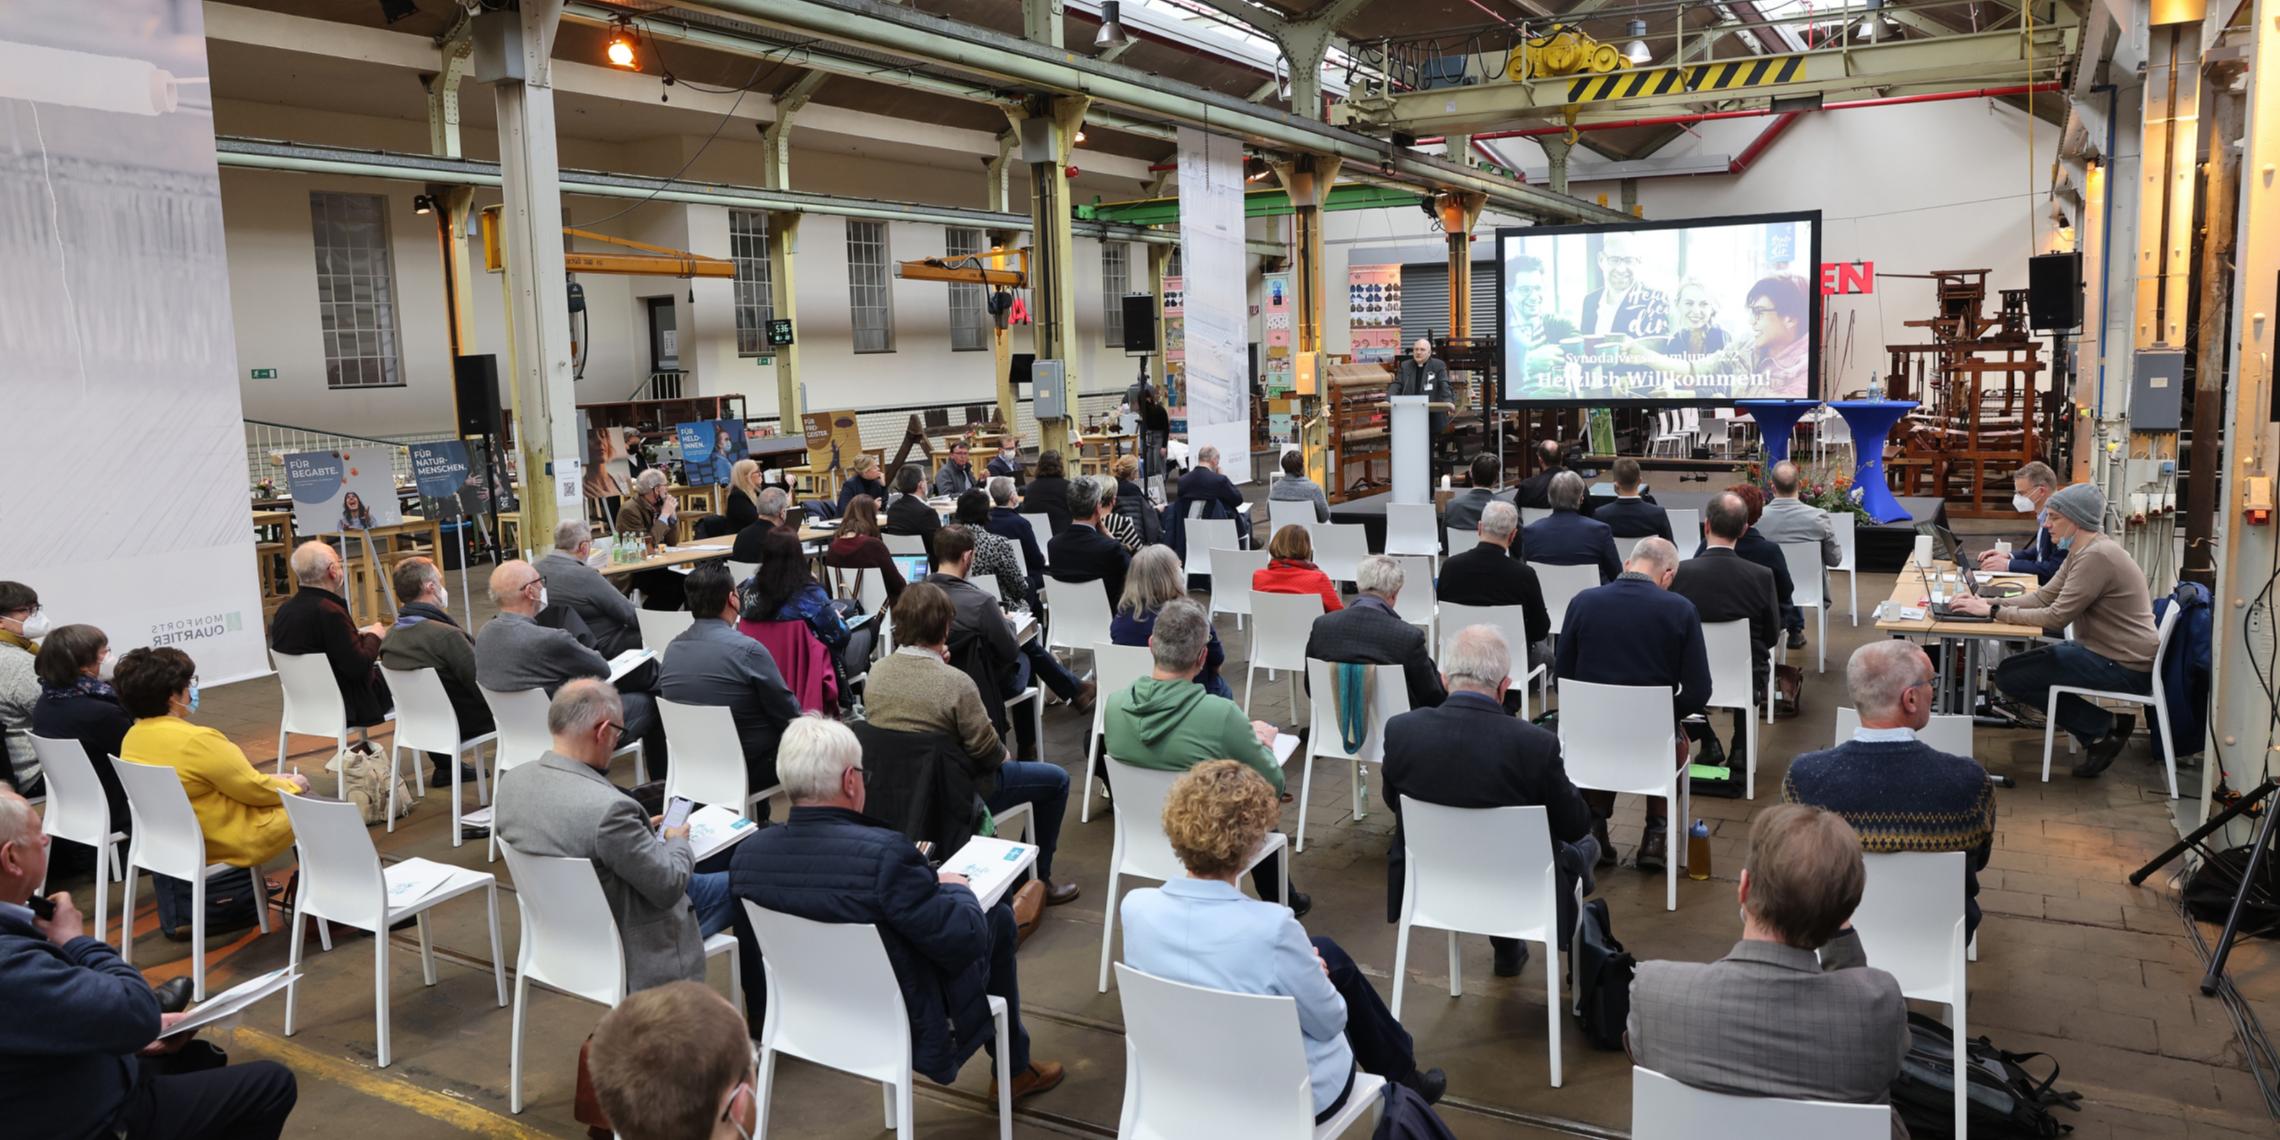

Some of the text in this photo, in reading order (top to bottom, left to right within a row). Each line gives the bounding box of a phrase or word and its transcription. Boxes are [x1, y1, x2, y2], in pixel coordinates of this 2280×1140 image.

[1628, 309, 1668, 337] dir
[1536, 370, 1771, 387] Hezlich Willkommen!
[680, 427, 694, 435] FÜR
[414, 448, 432, 459] FÜR
[290, 459, 310, 469] FÜR
[416, 456, 448, 467] NATUR-
[292, 466, 339, 478] BEGABTE.
[418, 463, 468, 475] MENSCHEN.
